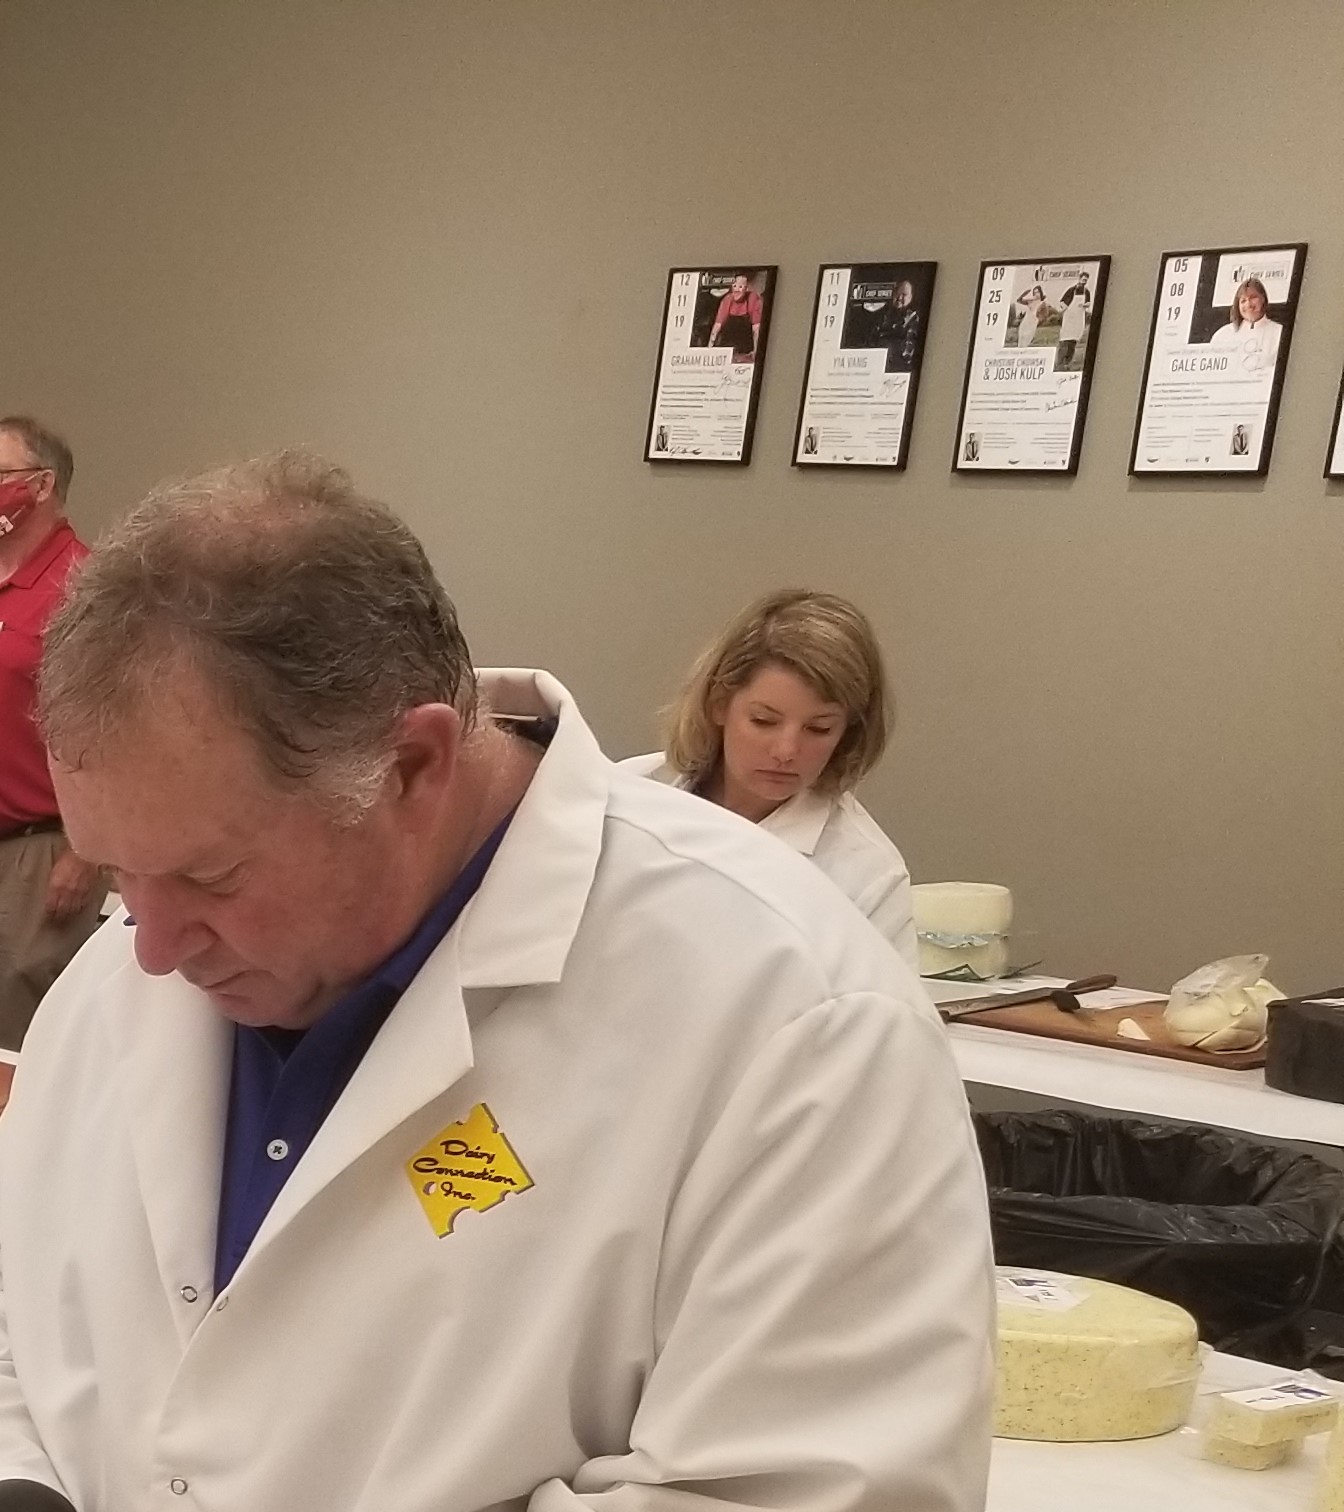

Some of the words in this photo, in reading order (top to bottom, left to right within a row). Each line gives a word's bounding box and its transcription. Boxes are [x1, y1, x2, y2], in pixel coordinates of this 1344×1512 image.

[1174, 258, 1188, 272] 05
[681, 274, 690, 286] 12
[830, 272, 840, 285] 11
[992, 267, 1004, 280] 09
[988, 289, 1003, 303] 25
[1170, 283, 1184, 296] 08
[677, 295, 687, 307] 11
[827, 293, 838, 307] 13
[986, 312, 998, 325] 19
[1167, 306, 1181, 321] 19
[675, 315, 685, 327] 19
[824, 315, 835, 328] 19
[670, 355, 701, 367] GRAHAM
[703, 354, 728, 366] ELLIOT
[1171, 358, 1198, 372] GALE
[1199, 357, 1228, 371] GAND
[983, 368, 990, 380] &
[993, 367, 1018, 380] JOSH
[1019, 367, 1045, 380] KULP
[440, 1139, 496, 1165] Dairy
[412, 1157, 518, 1186] Connection
